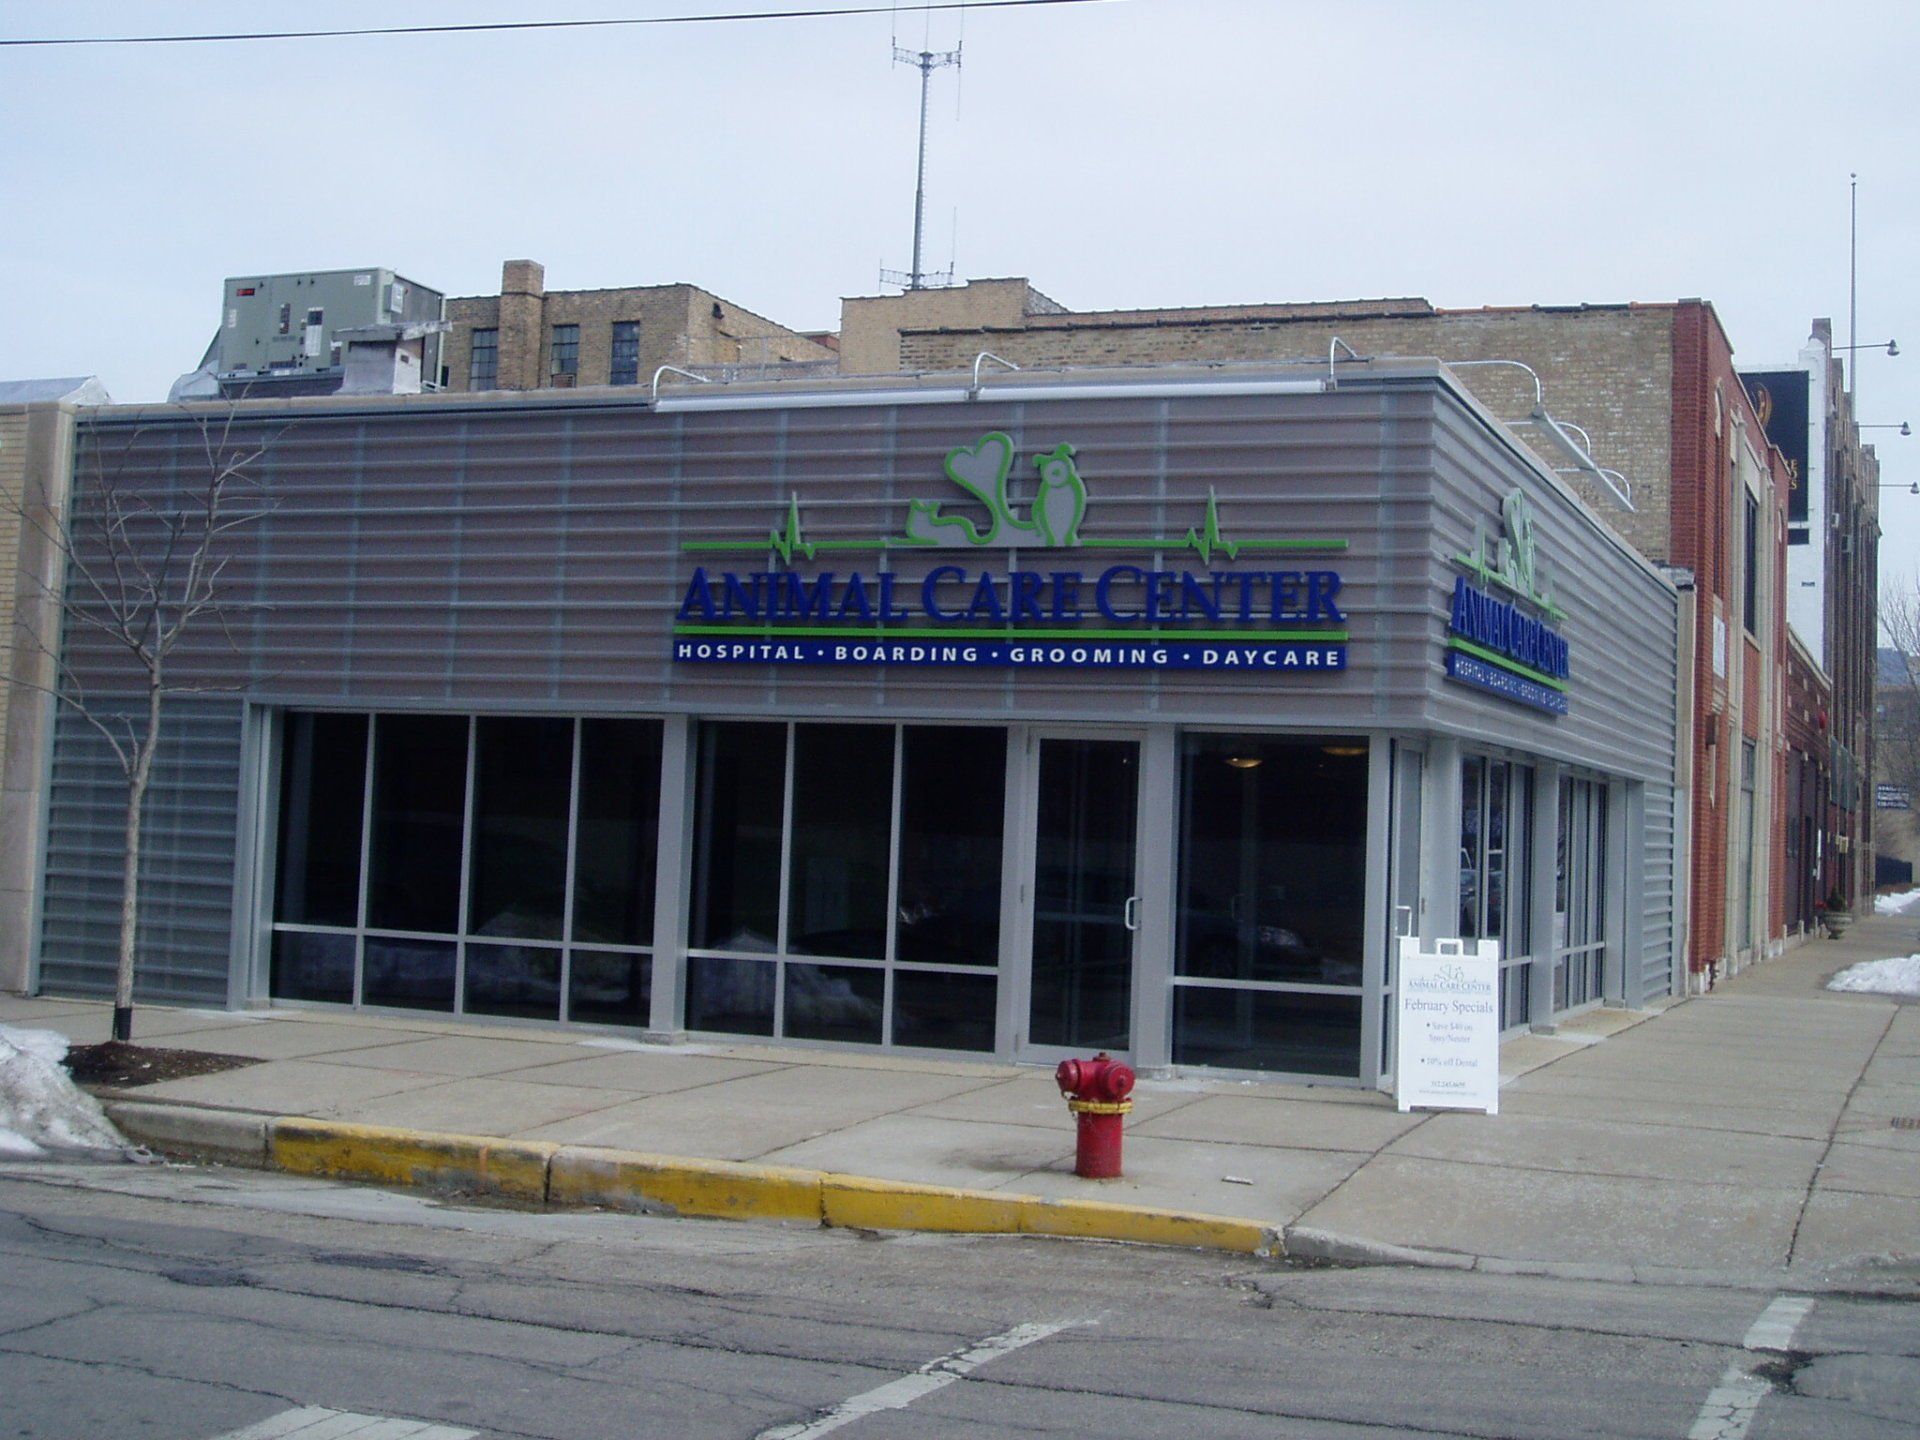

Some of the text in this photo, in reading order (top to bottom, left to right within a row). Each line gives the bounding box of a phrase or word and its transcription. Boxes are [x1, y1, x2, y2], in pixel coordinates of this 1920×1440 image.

[676, 565, 1346, 624] ANIMAL CARE CENTER
[678, 644, 1339, 666] HOSPITAL BOARDING GROOMING DAYCARE
[1404, 998, 1493, 1015] February Specials
